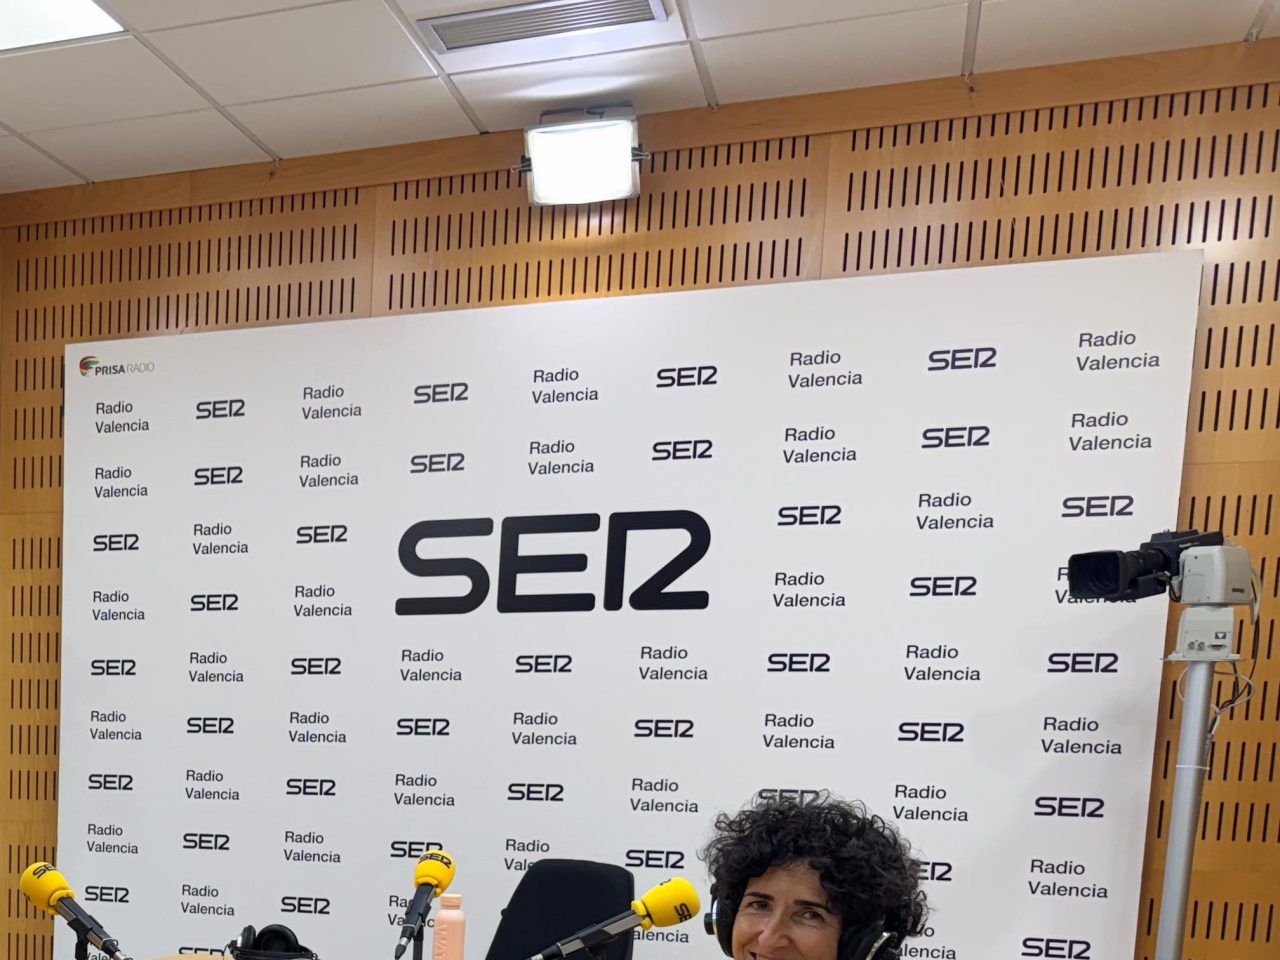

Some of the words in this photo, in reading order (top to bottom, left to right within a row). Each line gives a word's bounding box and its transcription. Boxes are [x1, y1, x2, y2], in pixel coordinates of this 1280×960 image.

[1079, 331, 1136, 348] Radio
[790, 350, 841, 366] Radio
[928, 347, 996, 371] SER
[1077, 352, 1160, 371] Valencia
[95, 364, 125, 376] PRISA
[126, 362, 155, 373] RADIO
[534, 368, 579, 383] Radio
[656, 366, 717, 388] SER
[788, 371, 862, 388] Valencia
[303, 385, 344, 399] Radio
[414, 383, 468, 404] SER
[532, 388, 598, 404] Valencia
[96, 401, 133, 414] Radio
[196, 399, 245, 419] SER
[302, 406, 361, 419] Valencia
[96, 419, 149, 433] Valencia
[1072, 412, 1128, 428] Radio
[785, 426, 835, 442] Radio
[921, 426, 990, 449] SER
[530, 440, 575, 454] Radio
[1069, 434, 1152, 451] Valencia
[652, 440, 713, 461] SER
[783, 447, 856, 463] Valencia
[301, 454, 341, 468] Radio
[410, 453, 465, 473] SER
[528, 460, 594, 475] Valencia
[95, 466, 131, 479] Radio
[194, 466, 243, 486] SER
[299, 473, 358, 487] Valencia
[94, 484, 148, 498] Valencia
[919, 492, 971, 508] Radio
[1061, 495, 1134, 517] SER
[777, 505, 841, 526] SER
[916, 514, 994, 529] Valencia
[194, 523, 232, 536] Radio
[296, 525, 347, 544] SER
[93, 534, 139, 552] SER
[193, 541, 248, 555] Valencia
[395, 510, 711, 616] SER
[775, 572, 824, 586] Radio
[909, 576, 977, 596] SER
[93, 591, 129, 602] Radio
[295, 585, 335, 597] Radio
[190, 594, 238, 611] SER
[773, 593, 845, 607] Valencia
[92, 608, 145, 620] Valencia
[294, 604, 352, 616] Valencia
[190, 652, 227, 664] Radio
[402, 649, 444, 662] Radio
[641, 646, 688, 659] Radio
[906, 645, 958, 659] Radio
[91, 659, 136, 676] SER
[291, 658, 341, 675] SER
[515, 655, 572, 673] SER
[767, 653, 830, 672] SER
[1047, 653, 1118, 673] SER
[189, 670, 243, 682] Valencia
[400, 668, 462, 681] Valencia
[639, 667, 708, 680] Valencia
[904, 667, 980, 680] Valencia
[91, 711, 126, 722] Radio
[290, 712, 329, 724] Radio
[513, 712, 558, 725] Radio
[765, 714, 814, 727] Radio
[1044, 717, 1099, 731] Radio
[187, 717, 234, 734] SER
[396, 718, 450, 736] SER
[634, 719, 694, 738] SER
[898, 722, 964, 742] SER
[90, 728, 142, 740] Valencia
[289, 730, 346, 743] Valencia
[512, 732, 577, 745] Valencia
[763, 734, 835, 749] Valencia
[1041, 739, 1122, 754] Valencia
[88, 774, 133, 790] SER
[186, 770, 223, 782] Radio
[395, 774, 437, 786] Radio
[286, 779, 336, 796] SER
[507, 783, 564, 802] SER
[632, 778, 678, 792] Radio
[895, 785, 946, 799] Radio
[185, 787, 239, 800] Valencia
[394, 793, 455, 806] Valencia
[630, 798, 698, 813] Valencia
[1034, 796, 1104, 818] SER
[893, 806, 968, 821] Valencia
[88, 824, 123, 836] Radio
[285, 831, 324, 844] Radio
[87, 841, 138, 854] Valencia
[183, 833, 230, 850] SER
[506, 839, 550, 852] Radio
[284, 849, 341, 863] Valencia
[625, 850, 685, 869] SER
[918, 861, 953, 882] ER
[1031, 859, 1085, 875] Radio
[85, 886, 129, 903] SER
[182, 884, 218, 897] Radio
[1028, 881, 1108, 898] Valencia
[181, 902, 234, 916] Valencia
[281, 896, 330, 915] SER
[633, 929, 689, 943] alencia
[1021, 937, 1091, 960] SER
